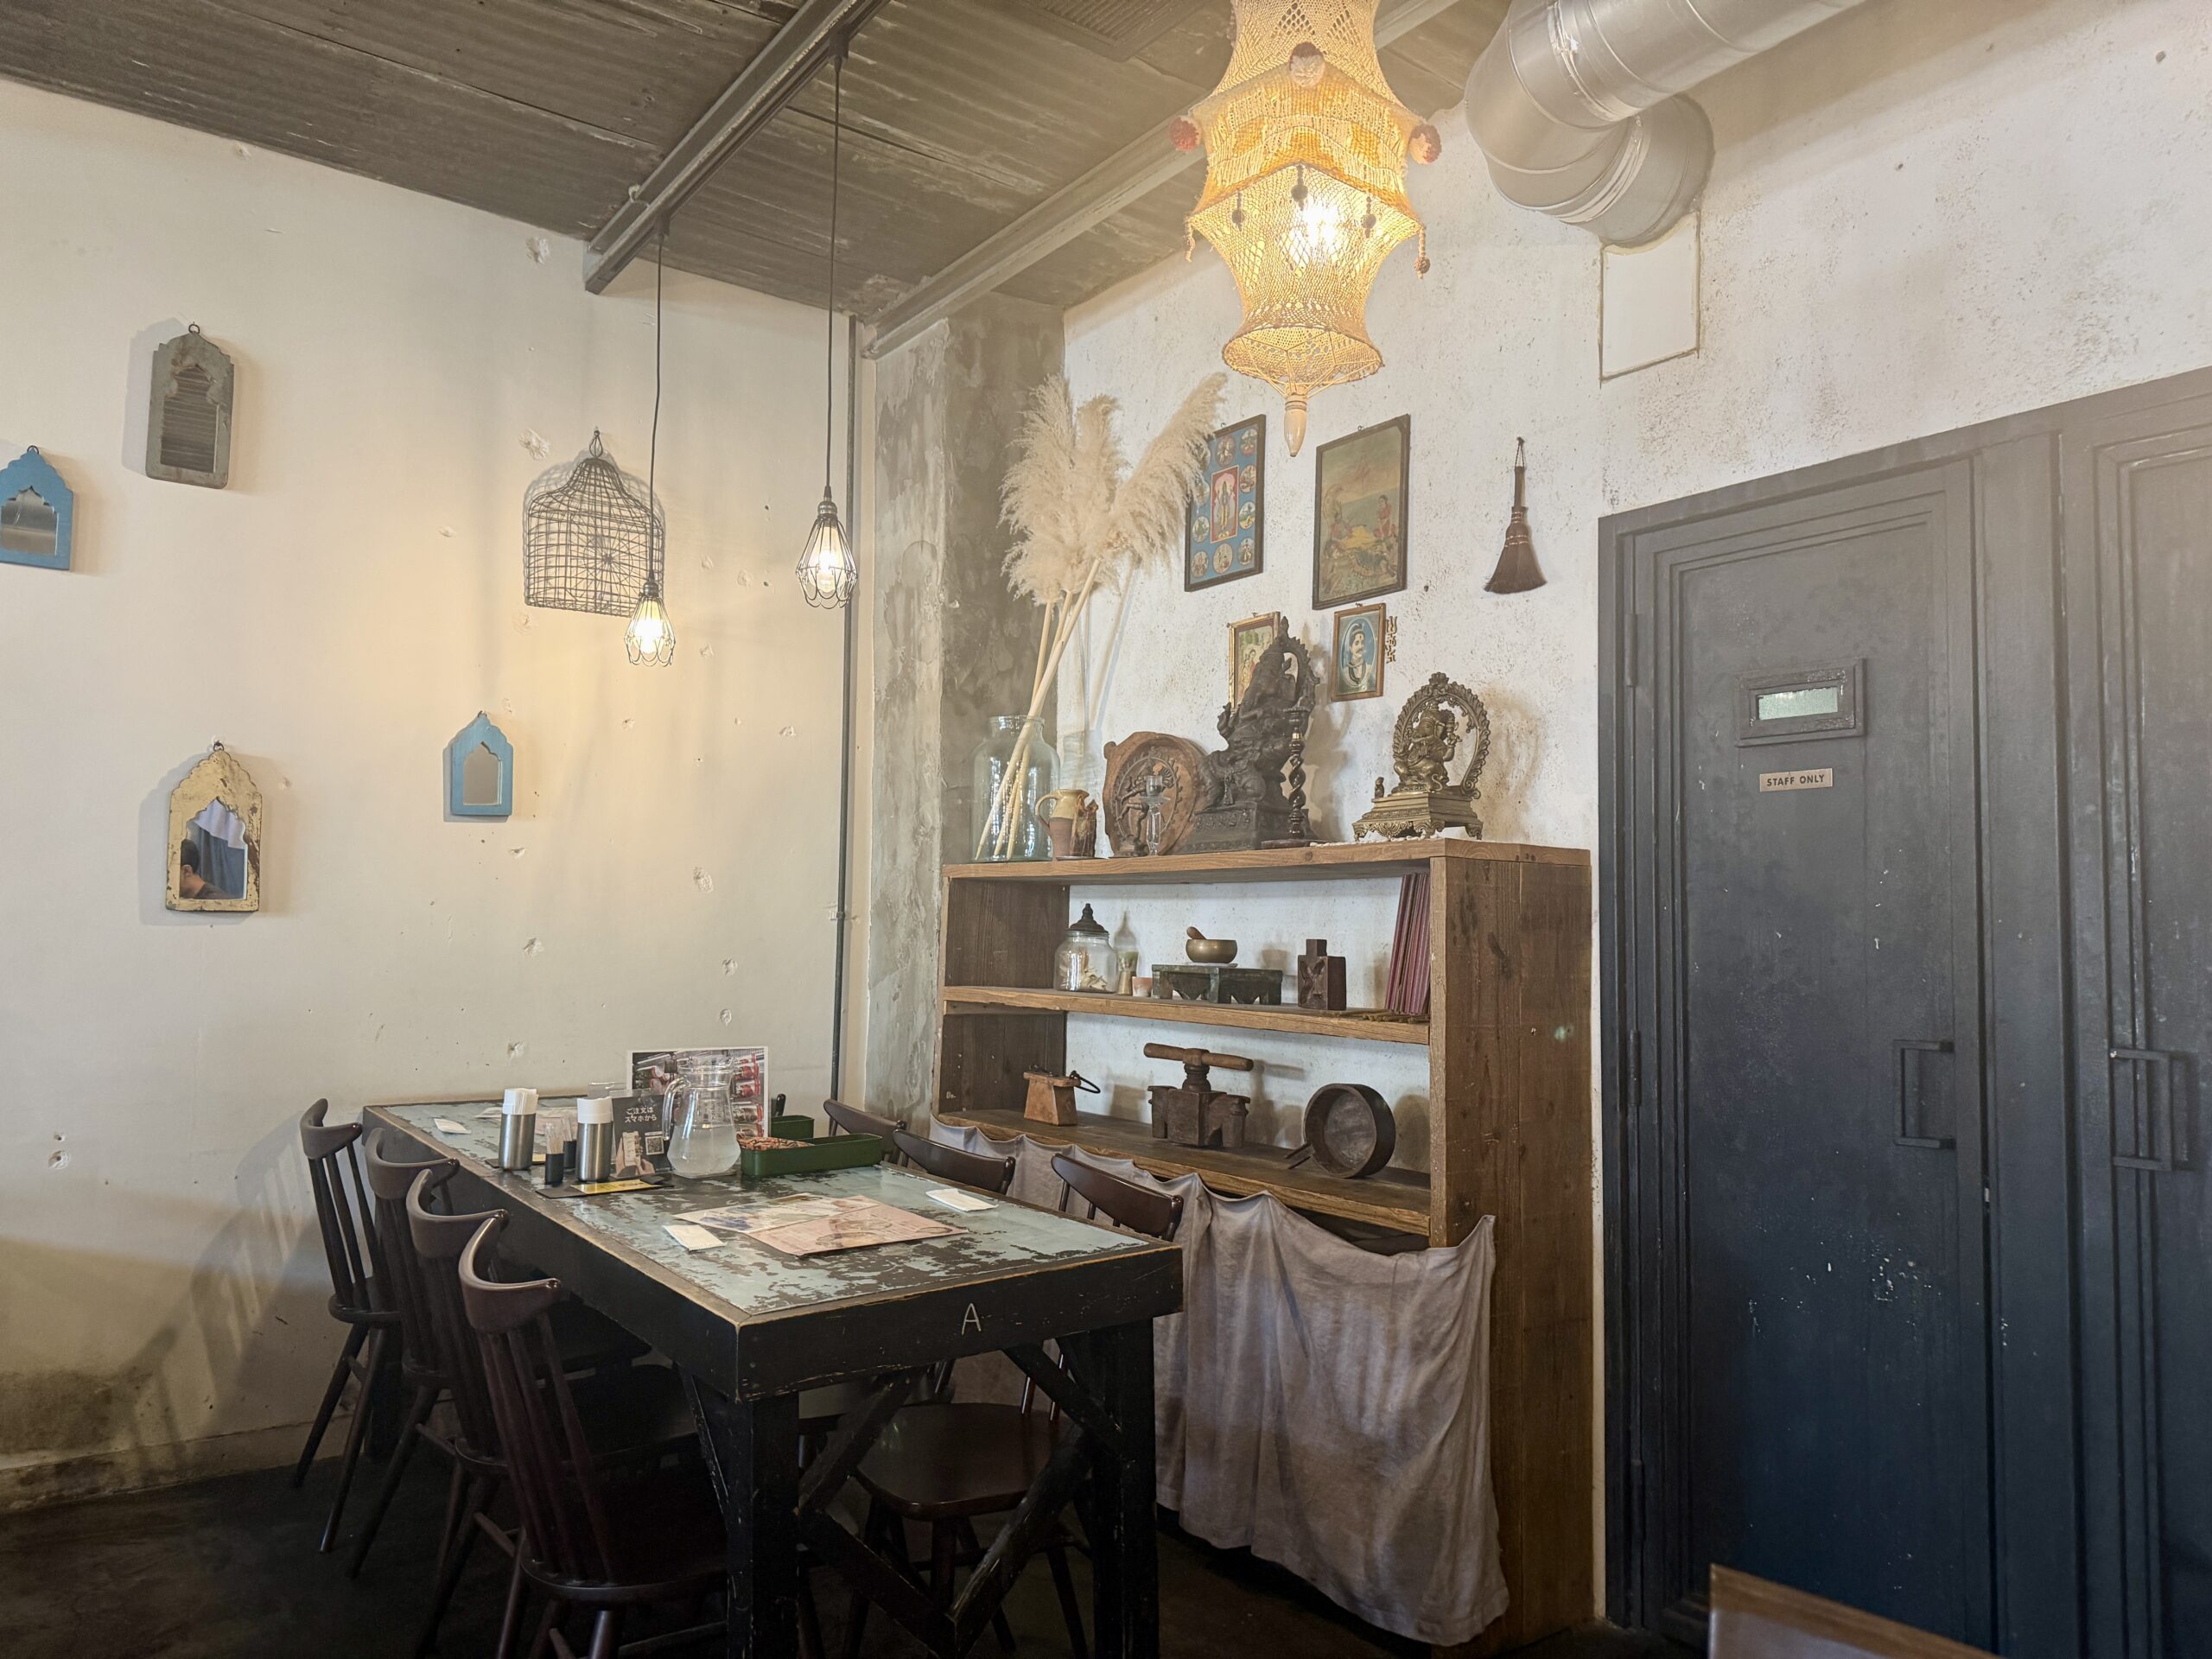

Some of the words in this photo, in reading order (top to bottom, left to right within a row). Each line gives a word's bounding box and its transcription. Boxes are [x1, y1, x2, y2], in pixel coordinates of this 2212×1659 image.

[1767, 776, 1795, 786] STAFF
[1800, 774, 1825, 784] ONLY
[625, 1115, 657, 1123] スマホから
[962, 1303, 982, 1335] A
